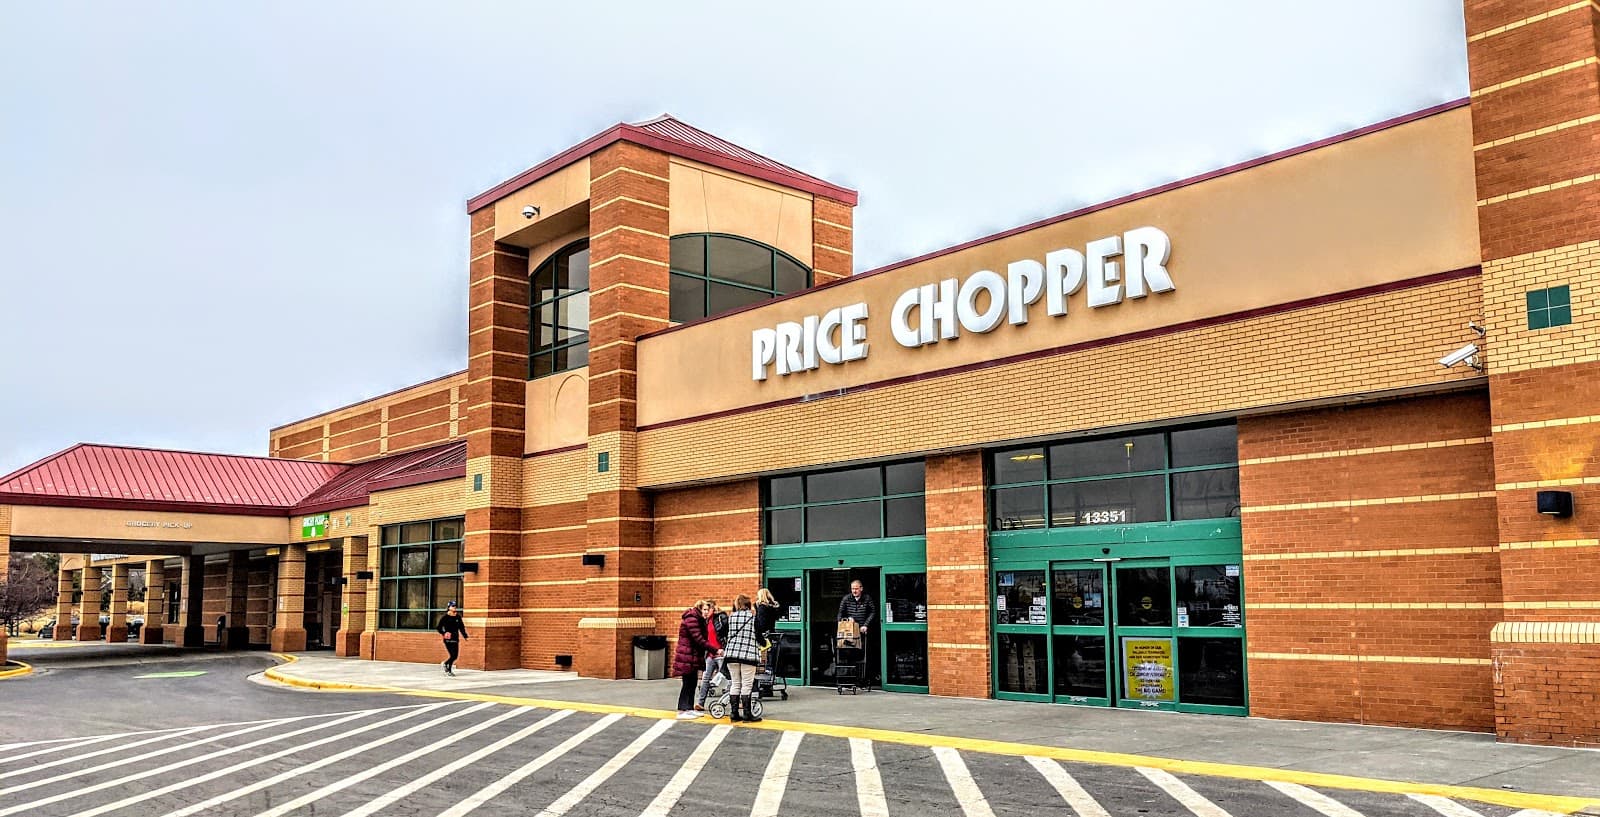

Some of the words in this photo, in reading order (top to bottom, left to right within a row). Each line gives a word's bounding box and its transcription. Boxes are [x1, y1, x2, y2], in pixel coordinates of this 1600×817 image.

[752, 302, 869, 381] PRICE
[890, 226, 1176, 348] CHOPPER
[126, 520, 161, 528] GROCERY
[1084, 510, 1126, 525] 13351
